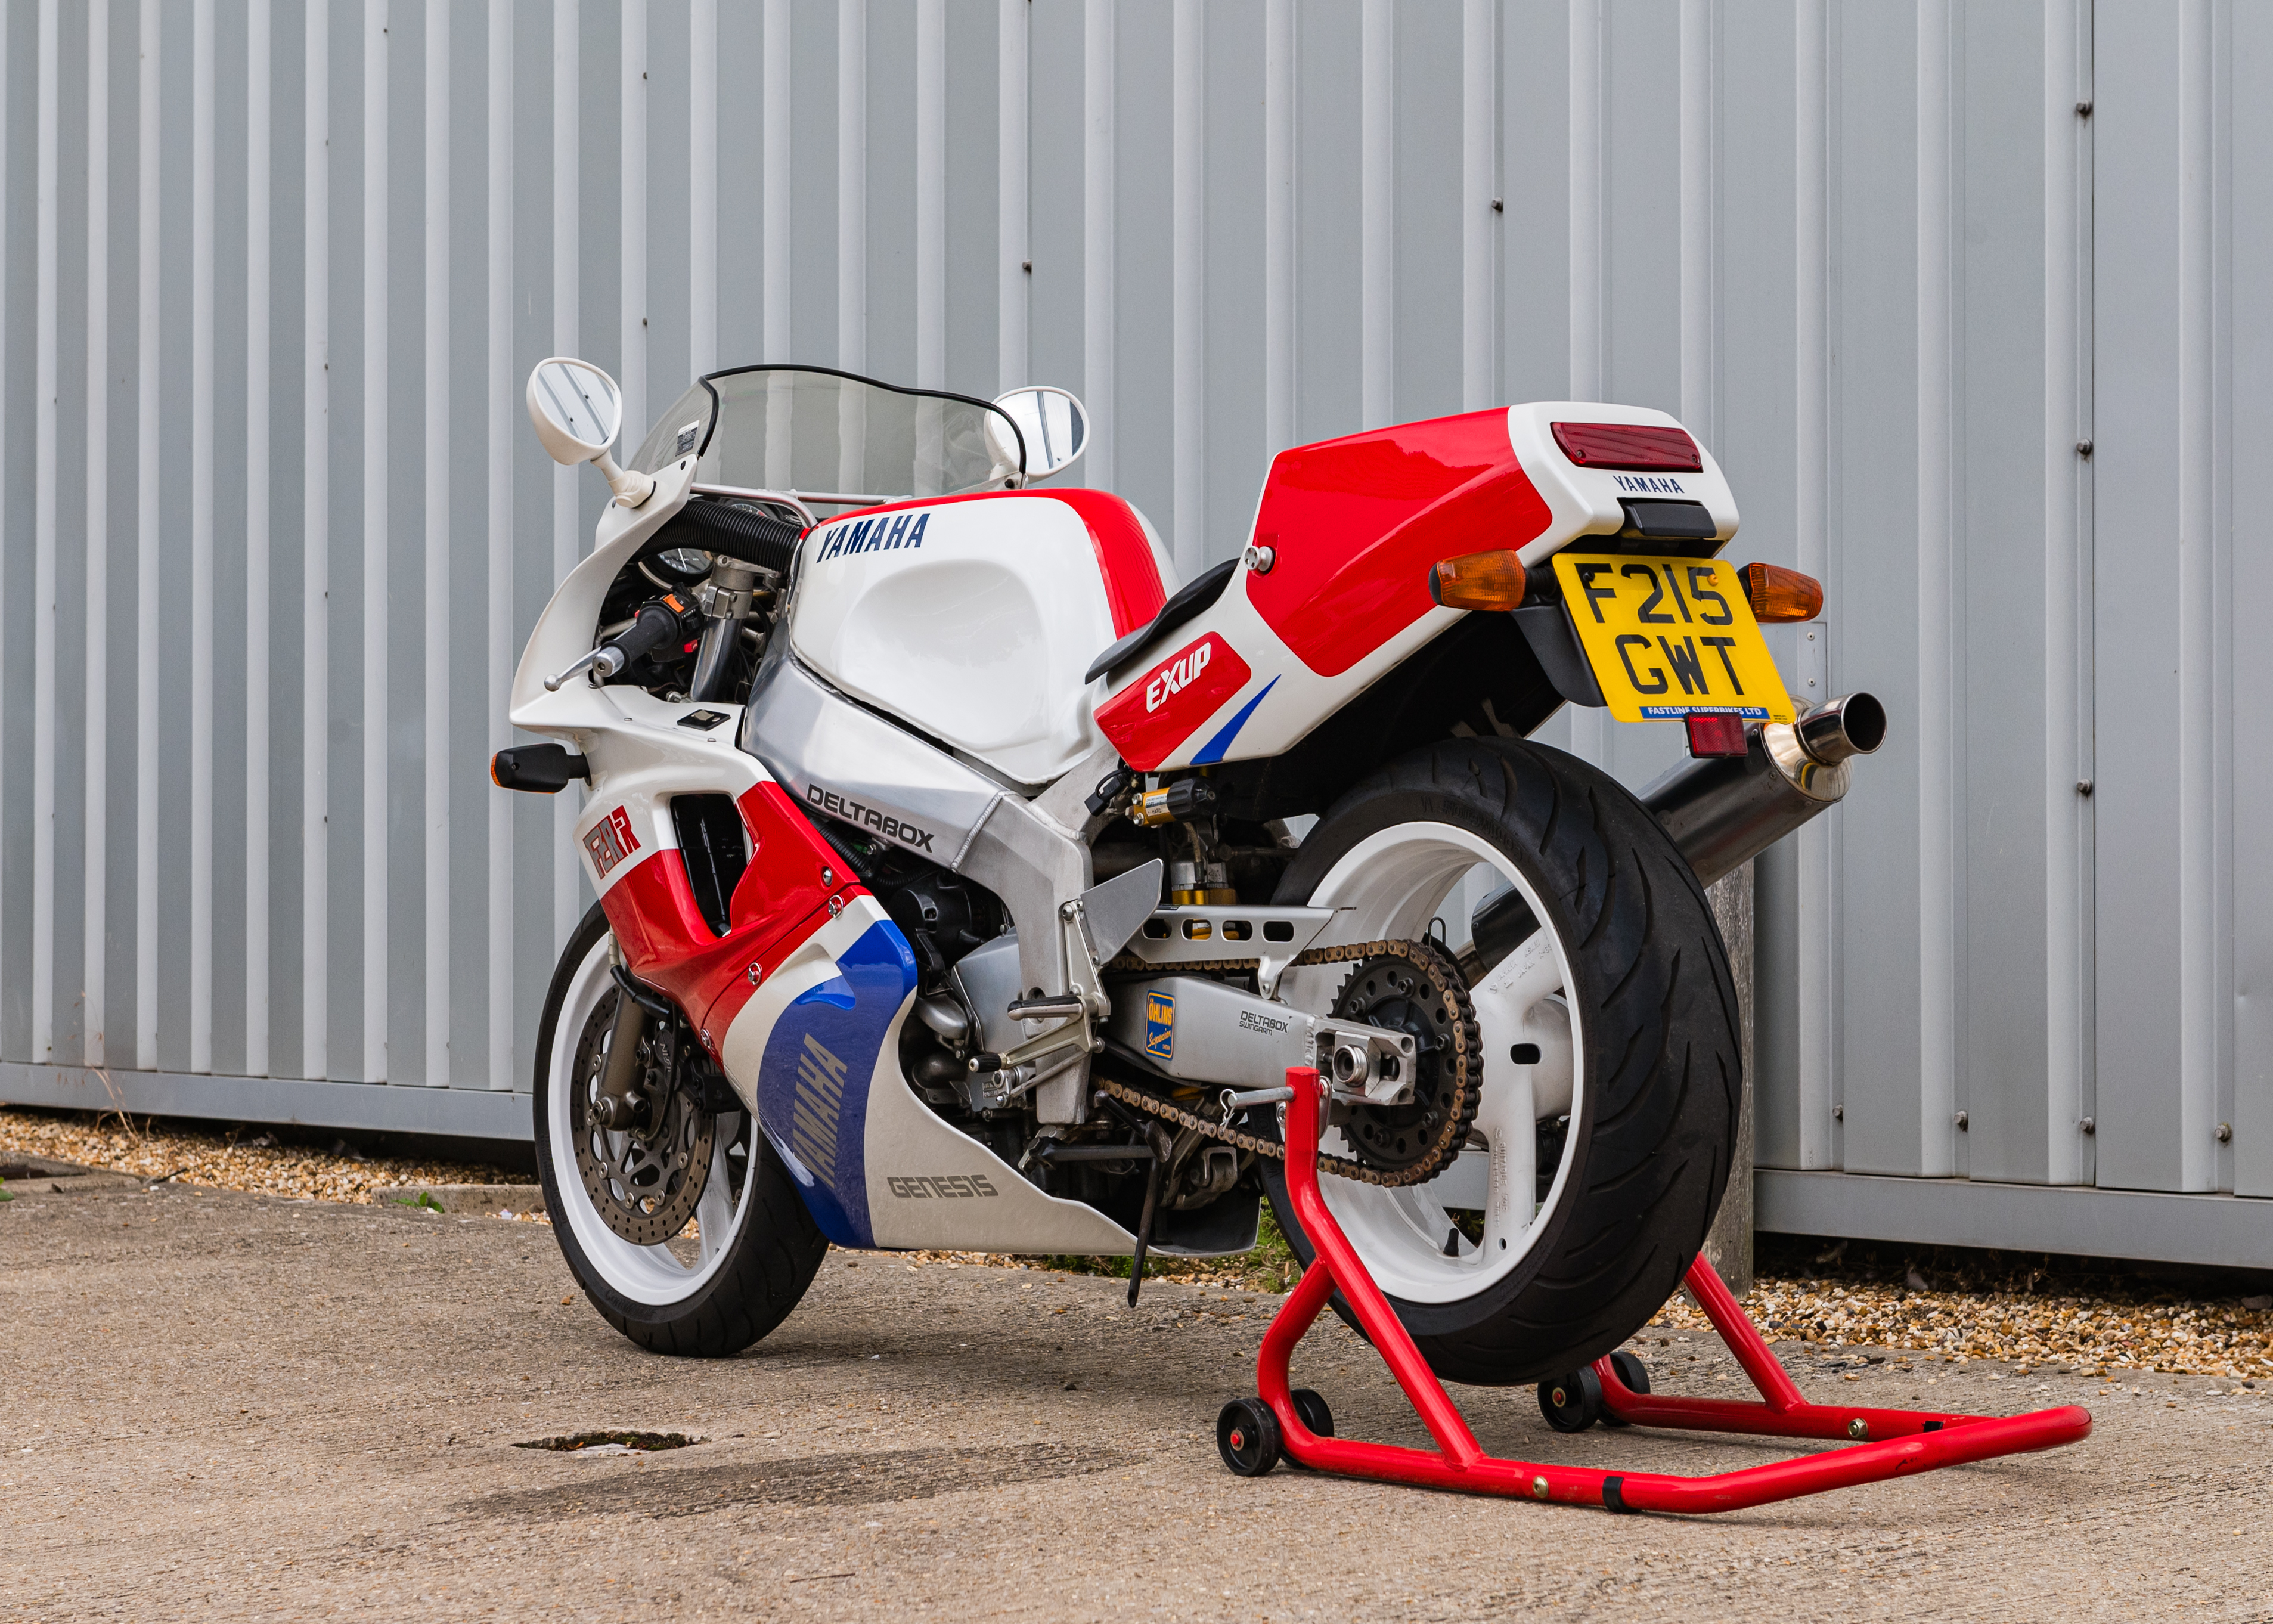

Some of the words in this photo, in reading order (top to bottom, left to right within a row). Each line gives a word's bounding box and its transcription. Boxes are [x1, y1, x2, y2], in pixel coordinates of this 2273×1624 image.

[1613, 475, 1685, 494] YAMAHA
[816, 513, 931, 563] YAMAHA
[1574, 563, 1734, 626] F215
[1146, 641, 1211, 714] EXUP
[1615, 634, 1745, 695] GWT
[807, 783, 935, 853] DELTABOX
[1148, 997, 1173, 1026] ÖHLINS
[1239, 1020, 1273, 1036] SWINGARM
[1241, 1010, 1289, 1033] DELTABOX
[792, 1032, 848, 1189] YAMAHA
[887, 1174, 999, 1198] GENESIS
[1499, 1142, 1508, 1186] SUITABLE
